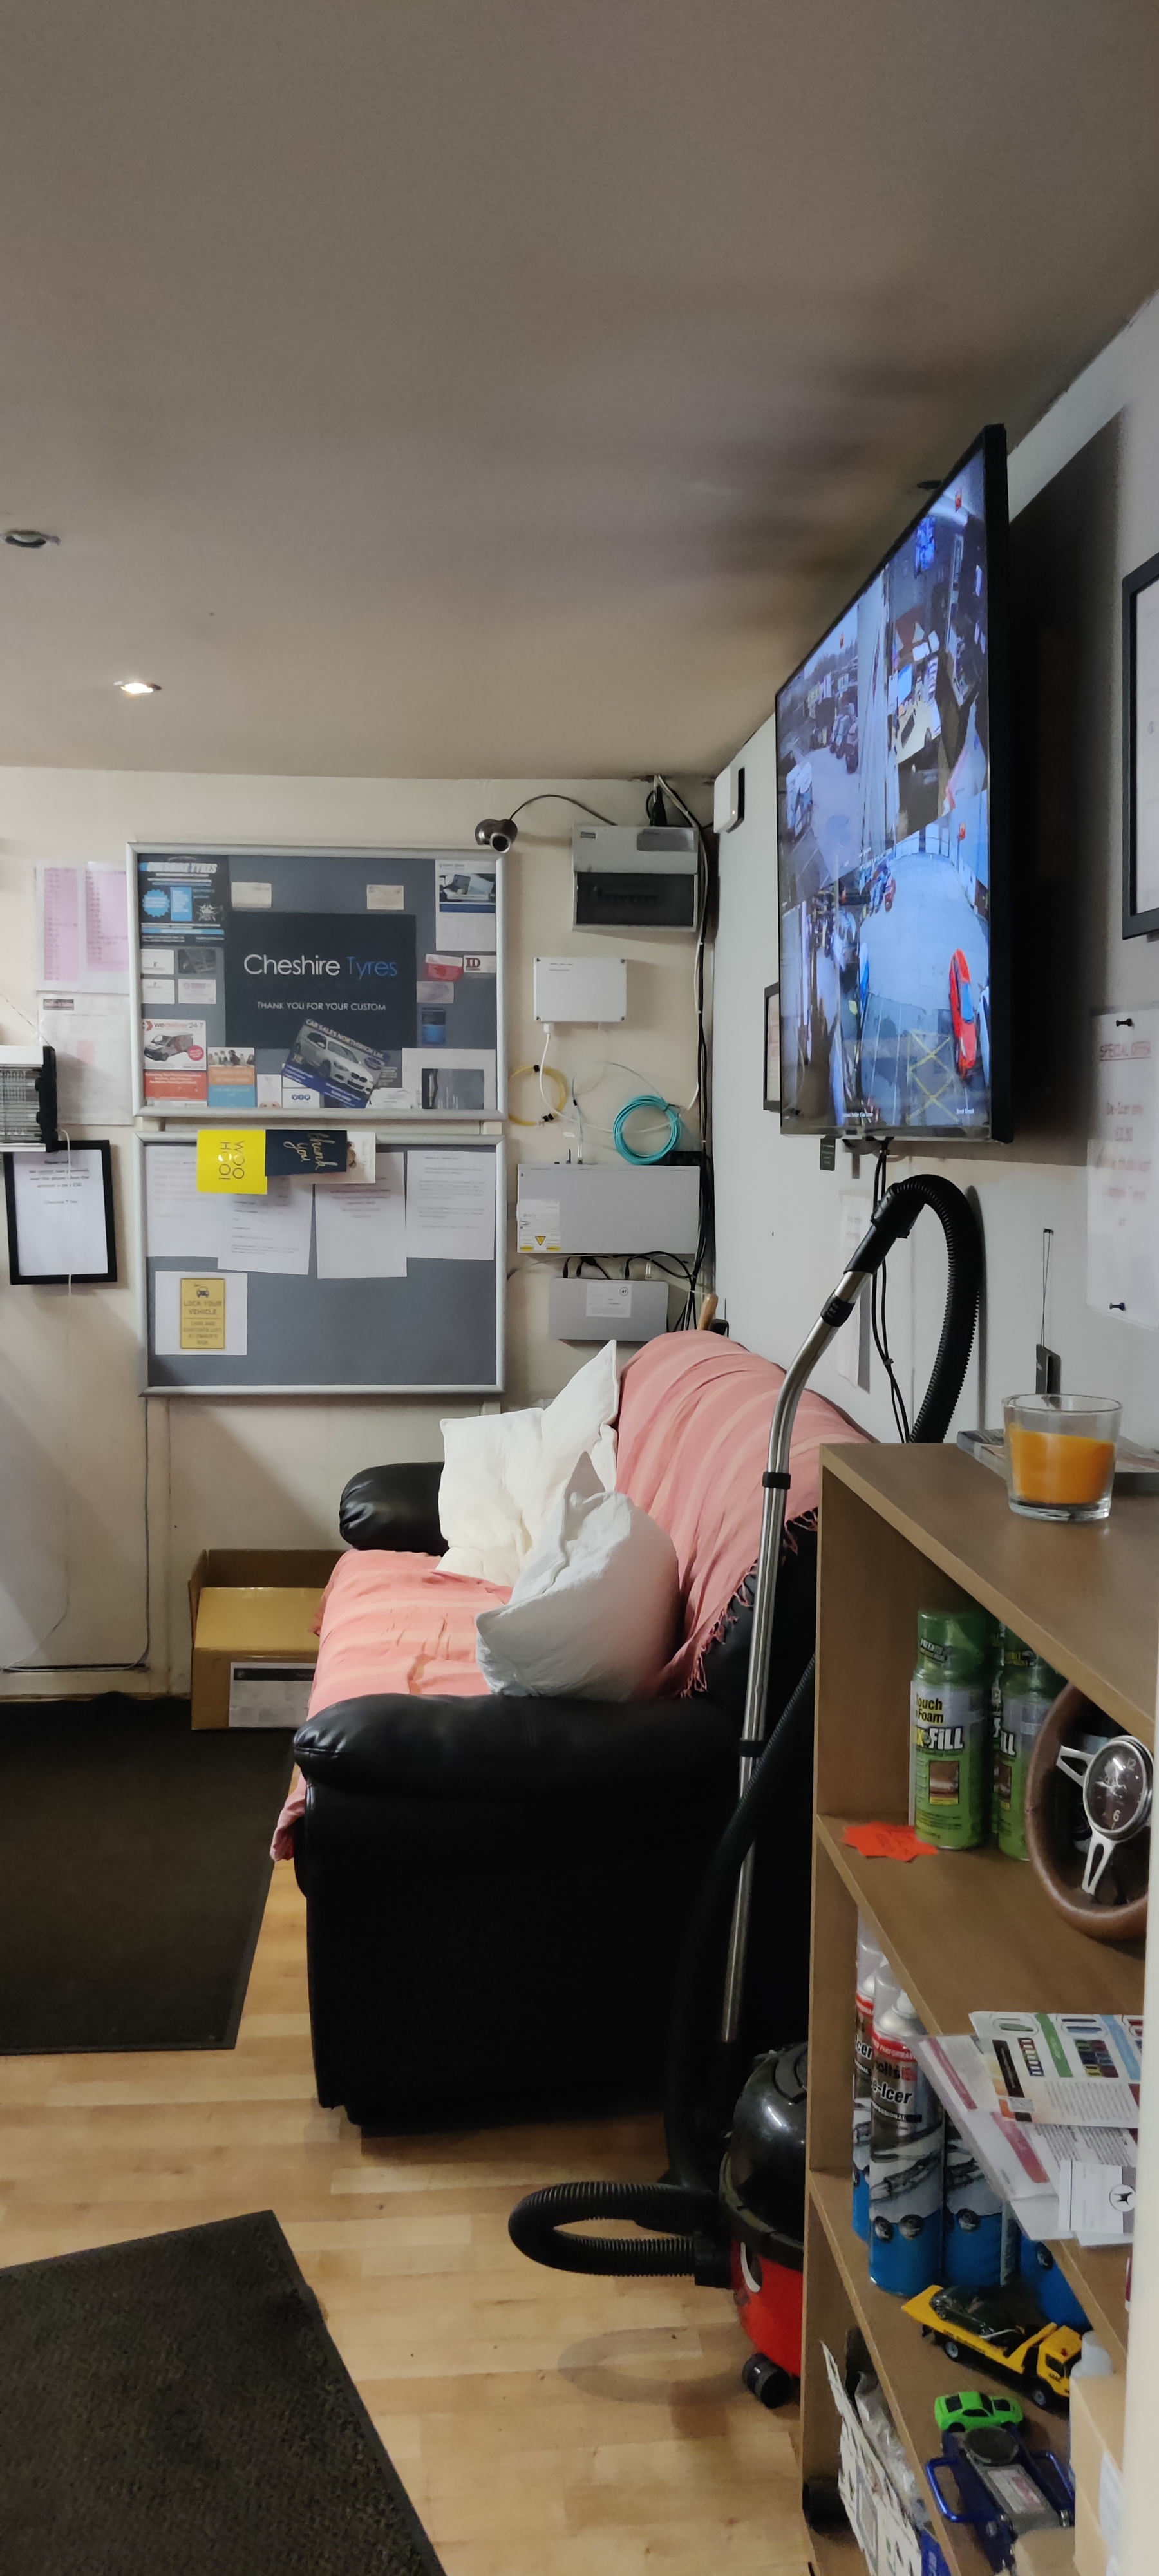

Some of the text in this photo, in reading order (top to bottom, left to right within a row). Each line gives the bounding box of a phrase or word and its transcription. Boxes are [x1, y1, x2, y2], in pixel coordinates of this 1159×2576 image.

[243, 954, 398, 980] Cheshire Tyres
[350, 1003, 386, 1011] CUSTOM
[1100, 1043, 1128, 1058] SPECIAL
[232, 1141, 245, 1179] WOO
[283, 1140, 311, 1163] you
[308, 1132, 339, 1171] thank
[918, 1708, 944, 1724] Foam
[1113, 1809, 1121, 1823] 6
[876, 2060, 901, 2079] olts
[872, 2079, 912, 2104] e-Icer
